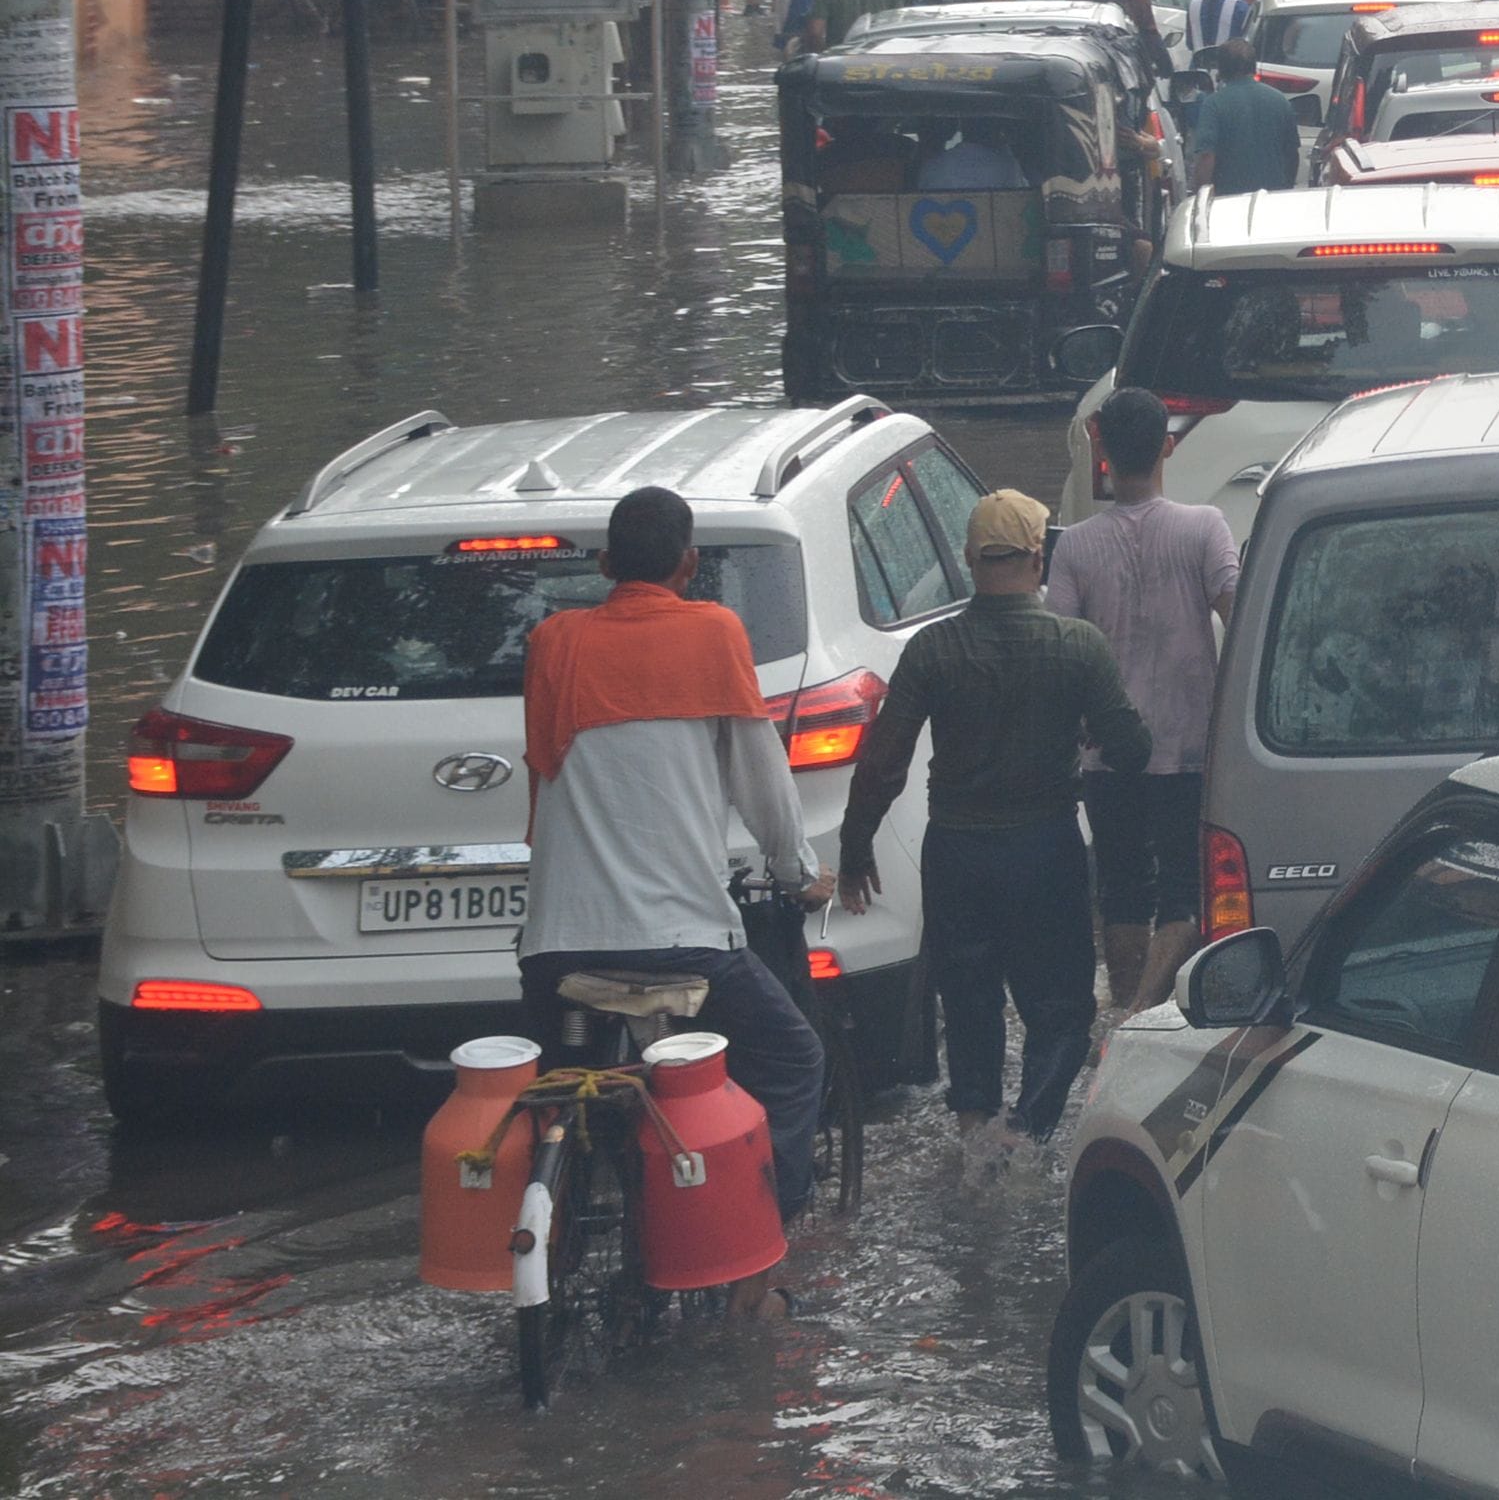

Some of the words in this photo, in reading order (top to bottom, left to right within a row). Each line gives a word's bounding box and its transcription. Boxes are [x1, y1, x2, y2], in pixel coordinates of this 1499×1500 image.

[14, 172, 62, 189] Batch
[1428, 268, 1451, 277] LIVE
[24, 381, 70, 398] Batch
[452, 551, 517, 564] SHIVANG
[519, 549, 588, 561] HYUNDAI
[331, 687, 364, 698] DEV
[365, 686, 399, 697] CAR
[206, 801, 261, 812] SHIVANG
[203, 812, 285, 825] CRETA
[1269, 863, 1338, 880] EECO
[384, 885, 528, 922] UP81BQ5
